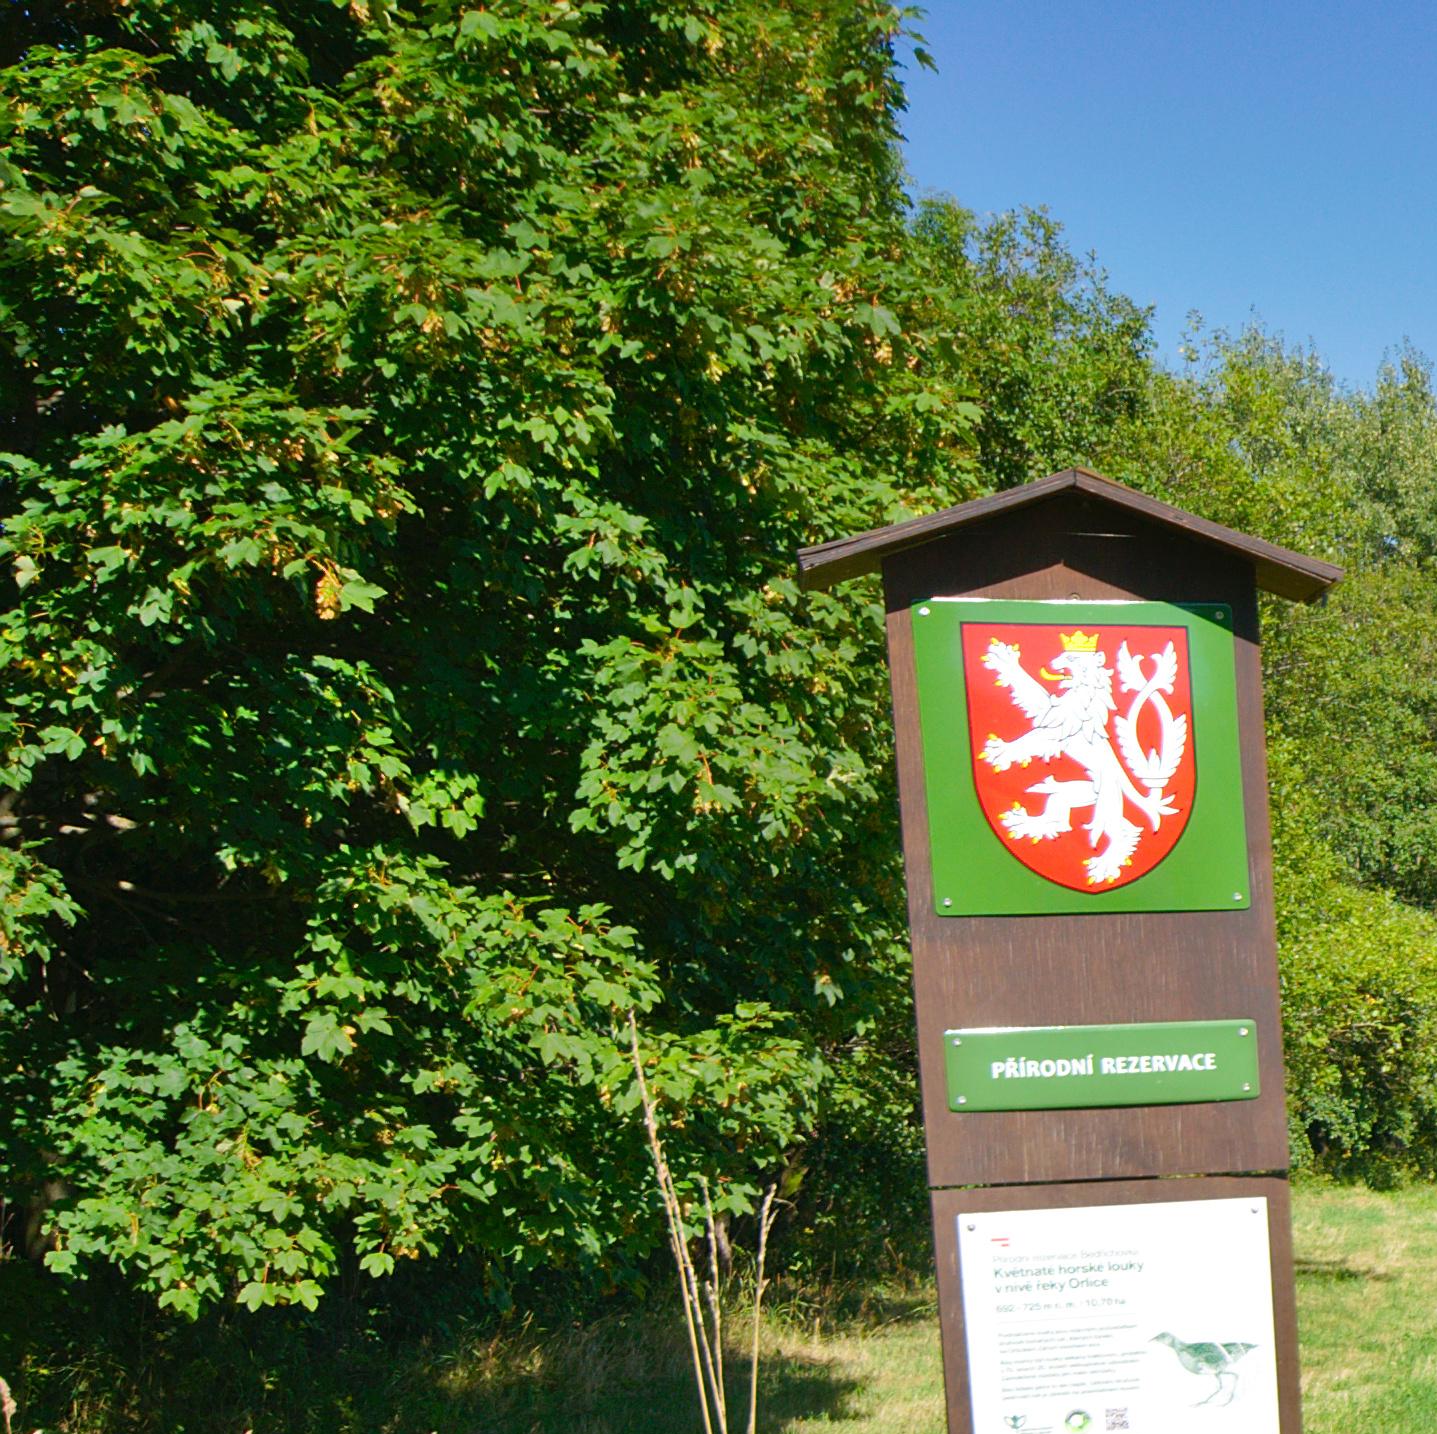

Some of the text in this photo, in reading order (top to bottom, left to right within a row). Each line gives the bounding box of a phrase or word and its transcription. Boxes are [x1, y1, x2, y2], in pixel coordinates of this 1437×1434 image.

[991, 1052, 1217, 1079] PŘÍRODNÍ REZERVACE
[1107, 1260, 1144, 1273] louky
[995, 1286, 1001, 1294] v
[1036, 1278, 1065, 1293] řeky
[1068, 1277, 1109, 1289] Orlice
